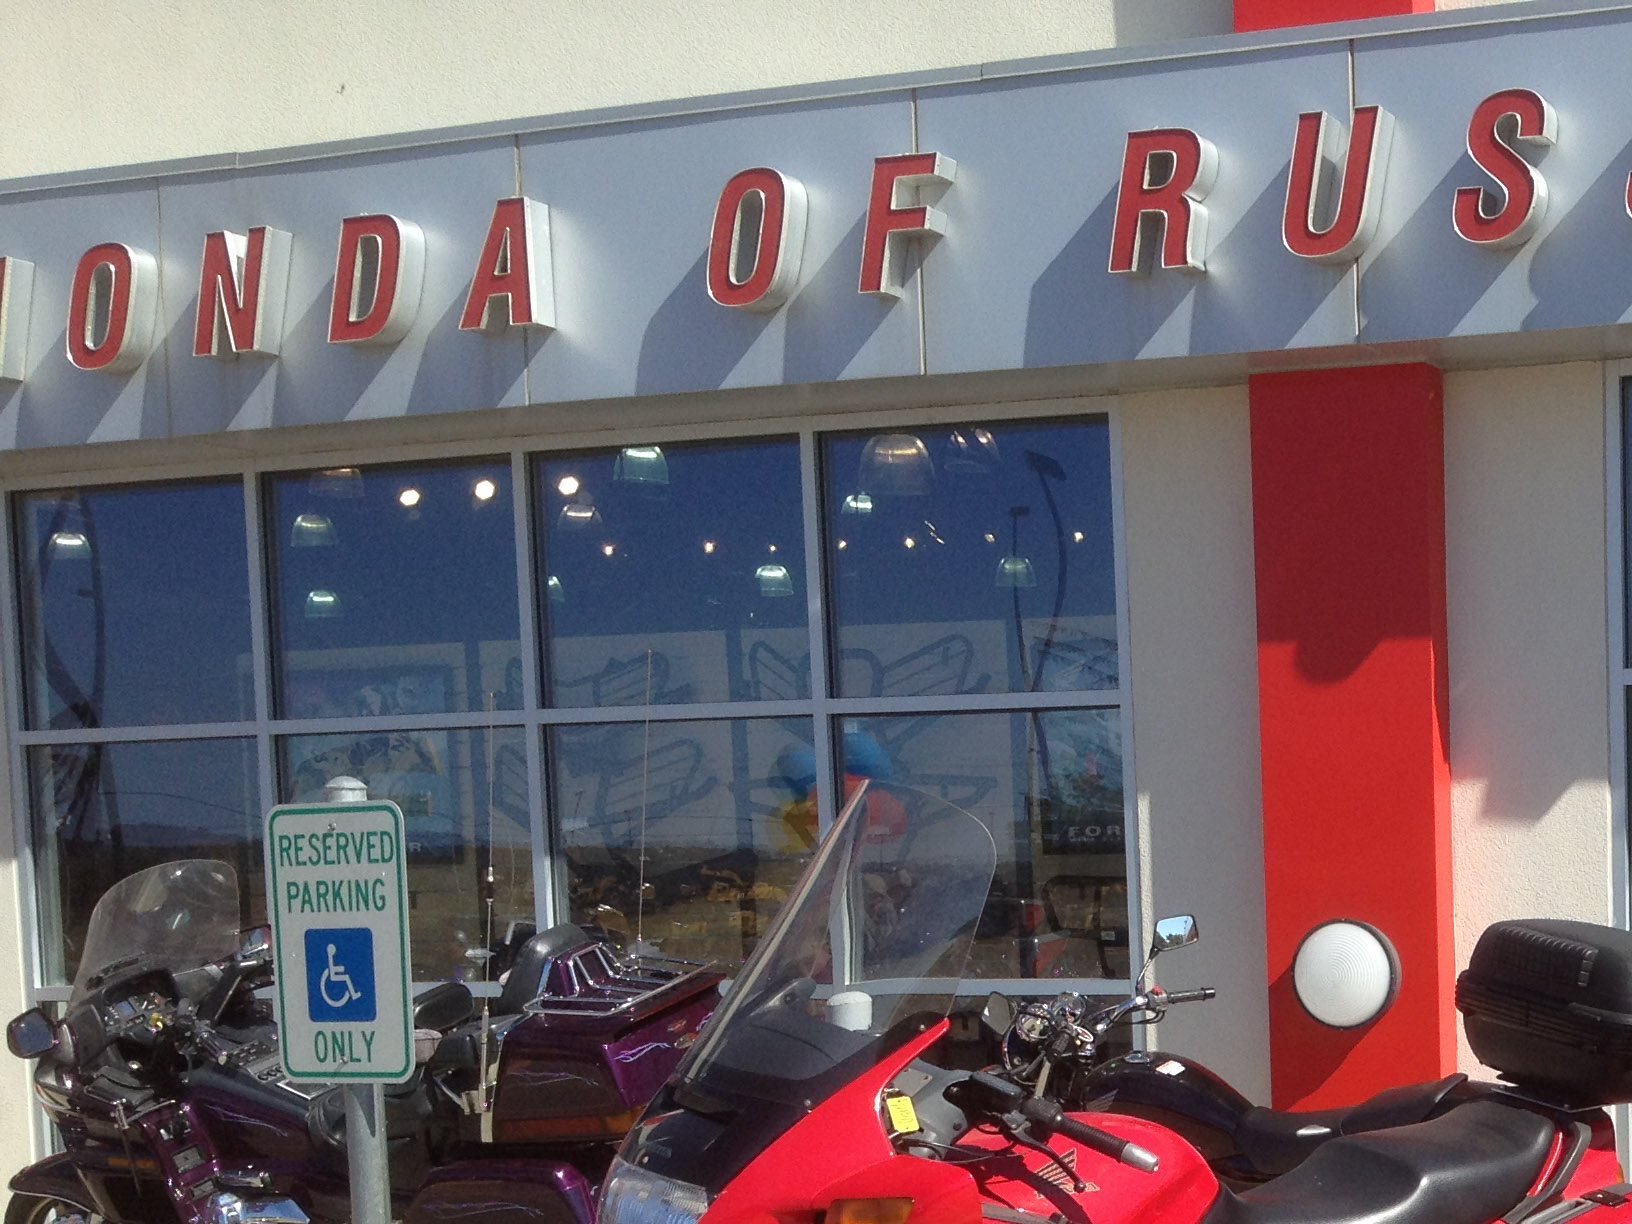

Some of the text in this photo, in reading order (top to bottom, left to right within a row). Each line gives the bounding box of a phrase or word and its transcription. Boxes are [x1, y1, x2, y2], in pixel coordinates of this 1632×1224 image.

[0, 197, 553, 383] ONDA
[706, 151, 956, 313] OF
[278, 831, 394, 867] RESERVED
[286, 878, 386, 913] PARKING
[314, 1030, 376, 1063] ONLY
